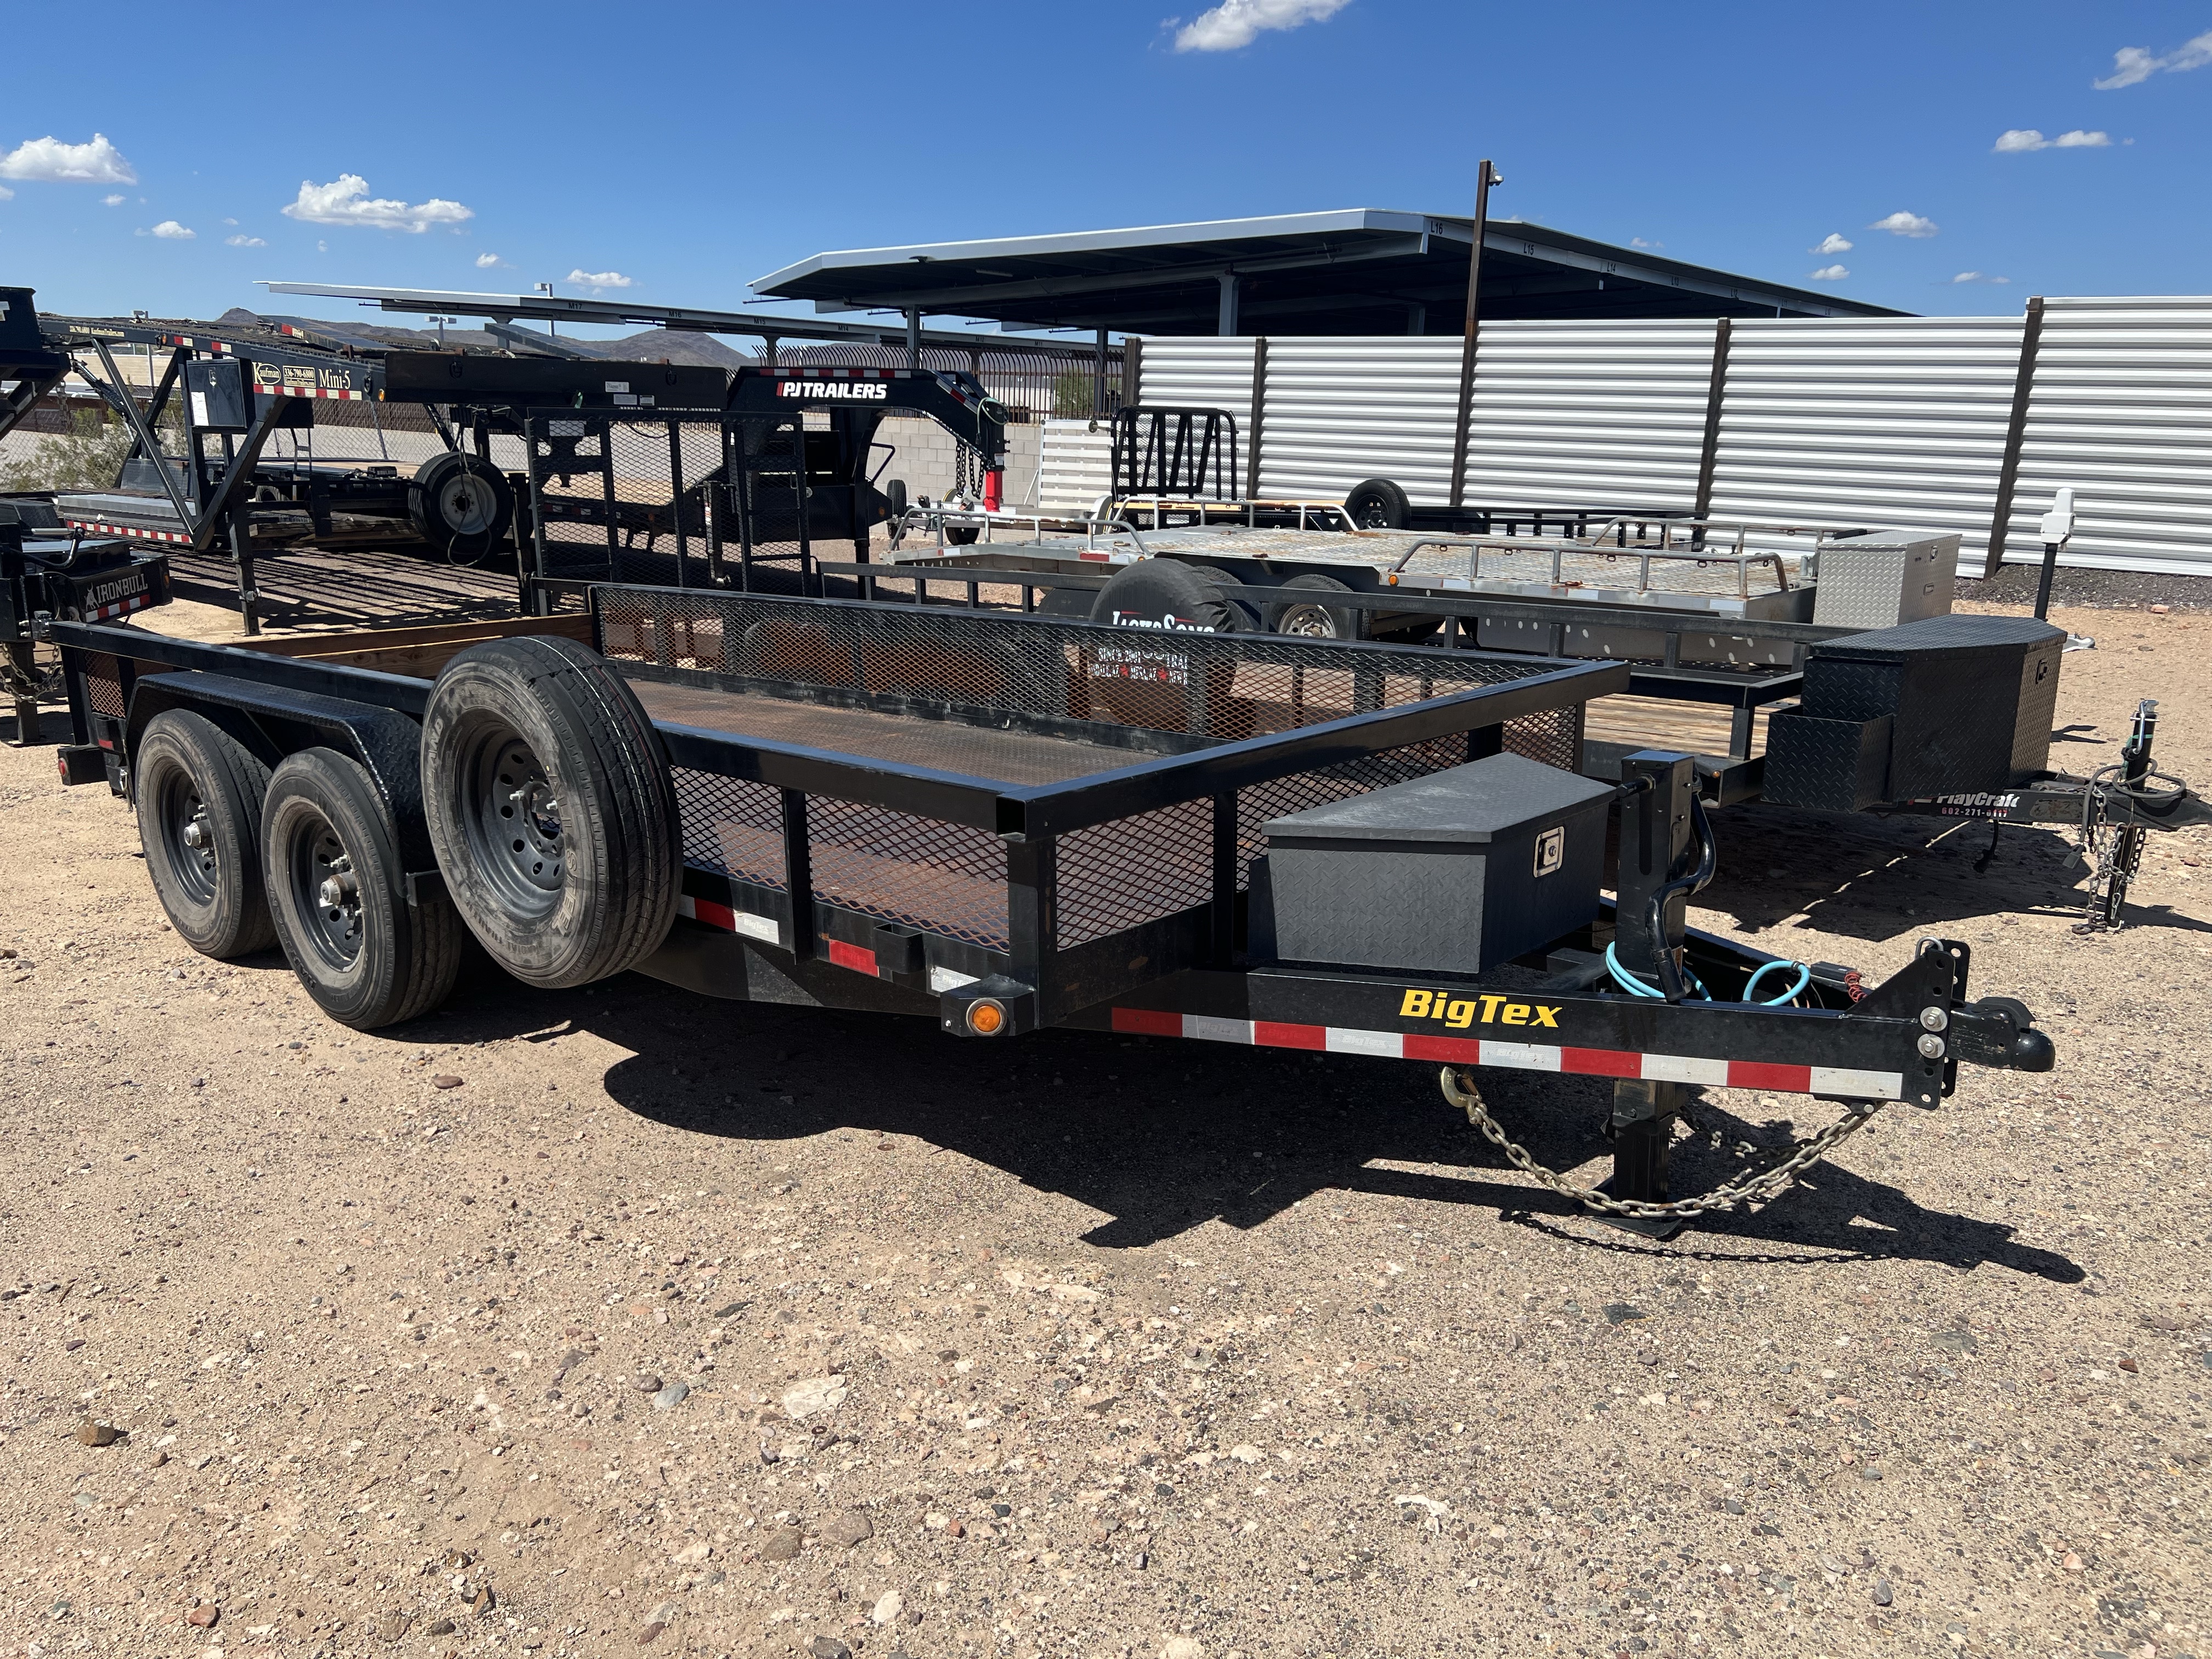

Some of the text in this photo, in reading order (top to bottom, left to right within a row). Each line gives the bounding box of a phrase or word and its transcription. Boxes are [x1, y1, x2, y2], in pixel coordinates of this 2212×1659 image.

[1431, 221, 1443, 235] L16
[1523, 242, 1534, 256] L15
[1607, 261, 1616, 274] L14
[1671, 276, 1680, 286] L13
[252, 362, 280, 385] Kaufman
[319, 368, 351, 389] Mini-5
[783, 382, 887, 399] PJ TRAILERS
[96, 573, 148, 604] IRONBULL
[551, 849, 578, 936] STEEL
[1400, 989, 1563, 1028] BigTex
[1342, 1035, 1387, 1048] BigTex
